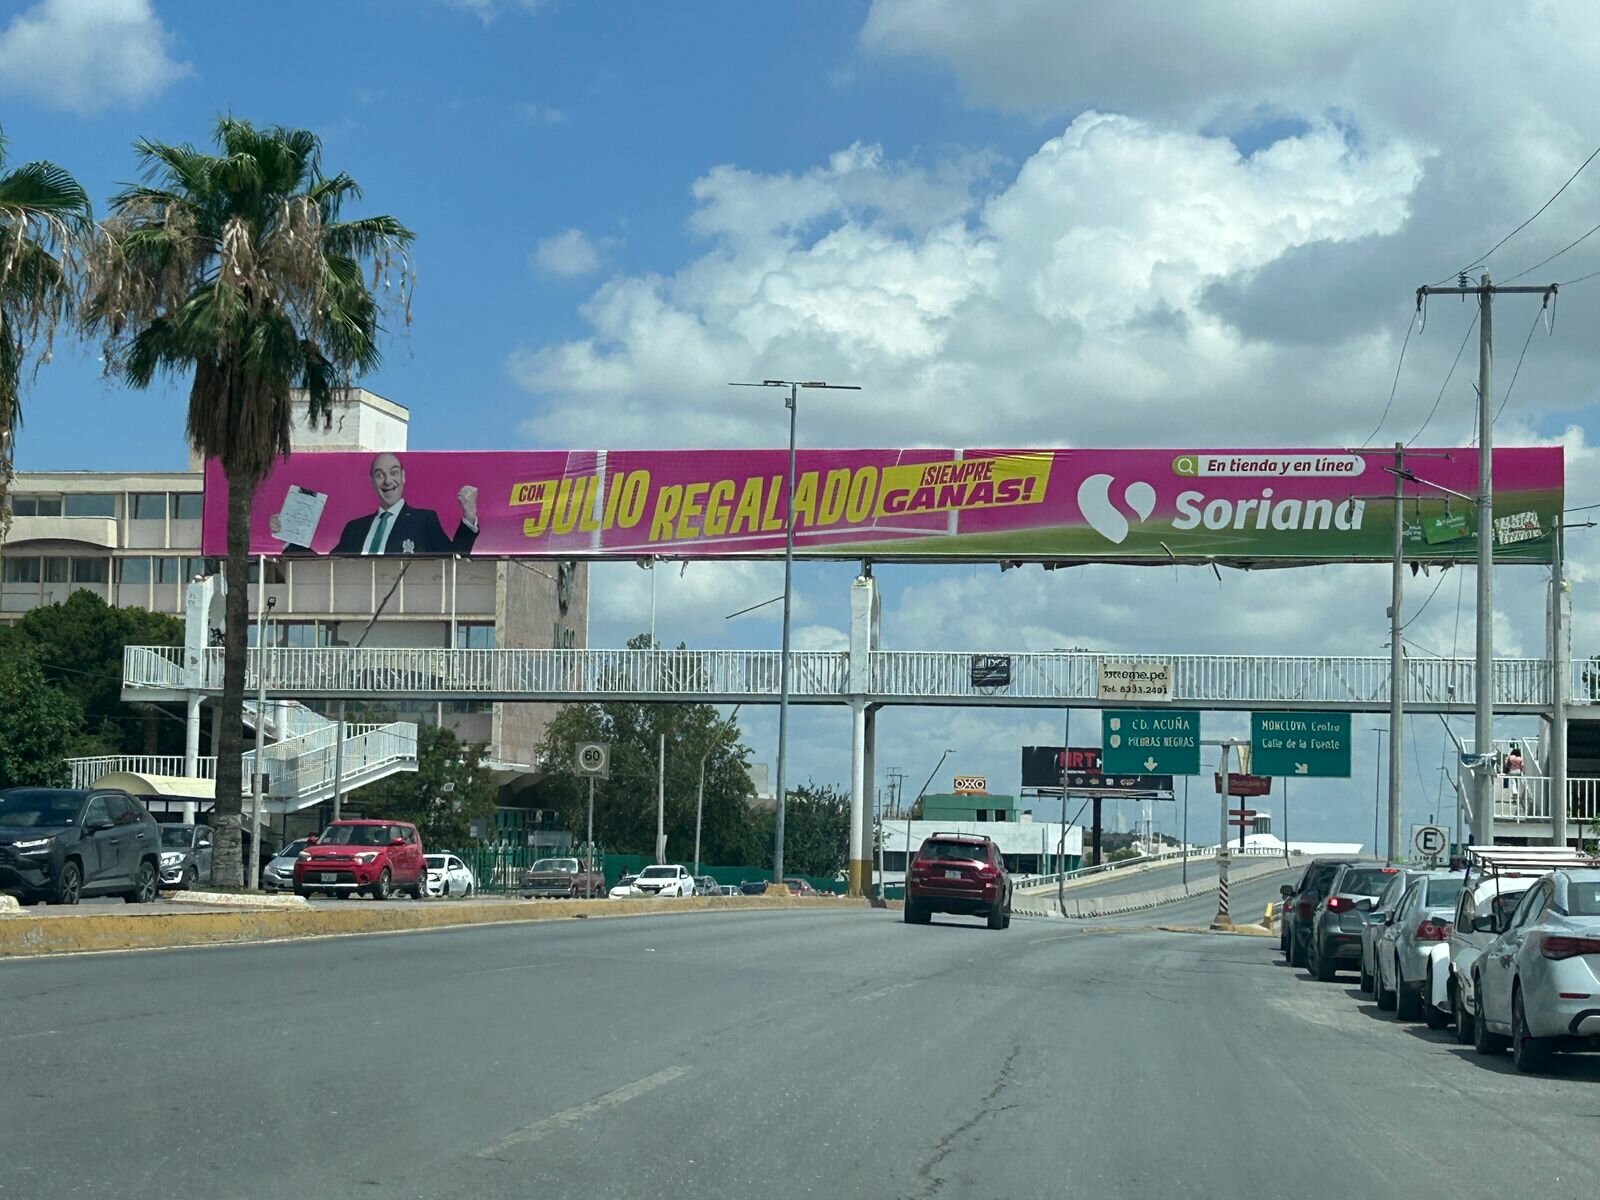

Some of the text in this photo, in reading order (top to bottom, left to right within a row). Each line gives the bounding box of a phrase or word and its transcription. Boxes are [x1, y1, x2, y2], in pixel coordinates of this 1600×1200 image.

[1207, 457, 1354, 475] En tienda y en línea
[883, 476, 1037, 514] GANAS!
[523, 469, 651, 538] JULIO
[648, 466, 878, 542] REGALADO
[1171, 487, 1366, 531] Soriana
[1153, 716, 1191, 730] ACUÑA
[1261, 719, 1341, 732] MONCLOVA Centro
[1163, 736, 1195, 748] NEGRAS
[1262, 738, 1341, 750] Calle de la Fuente
[584, 750, 600, 761] 60
[955, 779, 985, 789] OXXO
[1423, 831, 1438, 851] E
